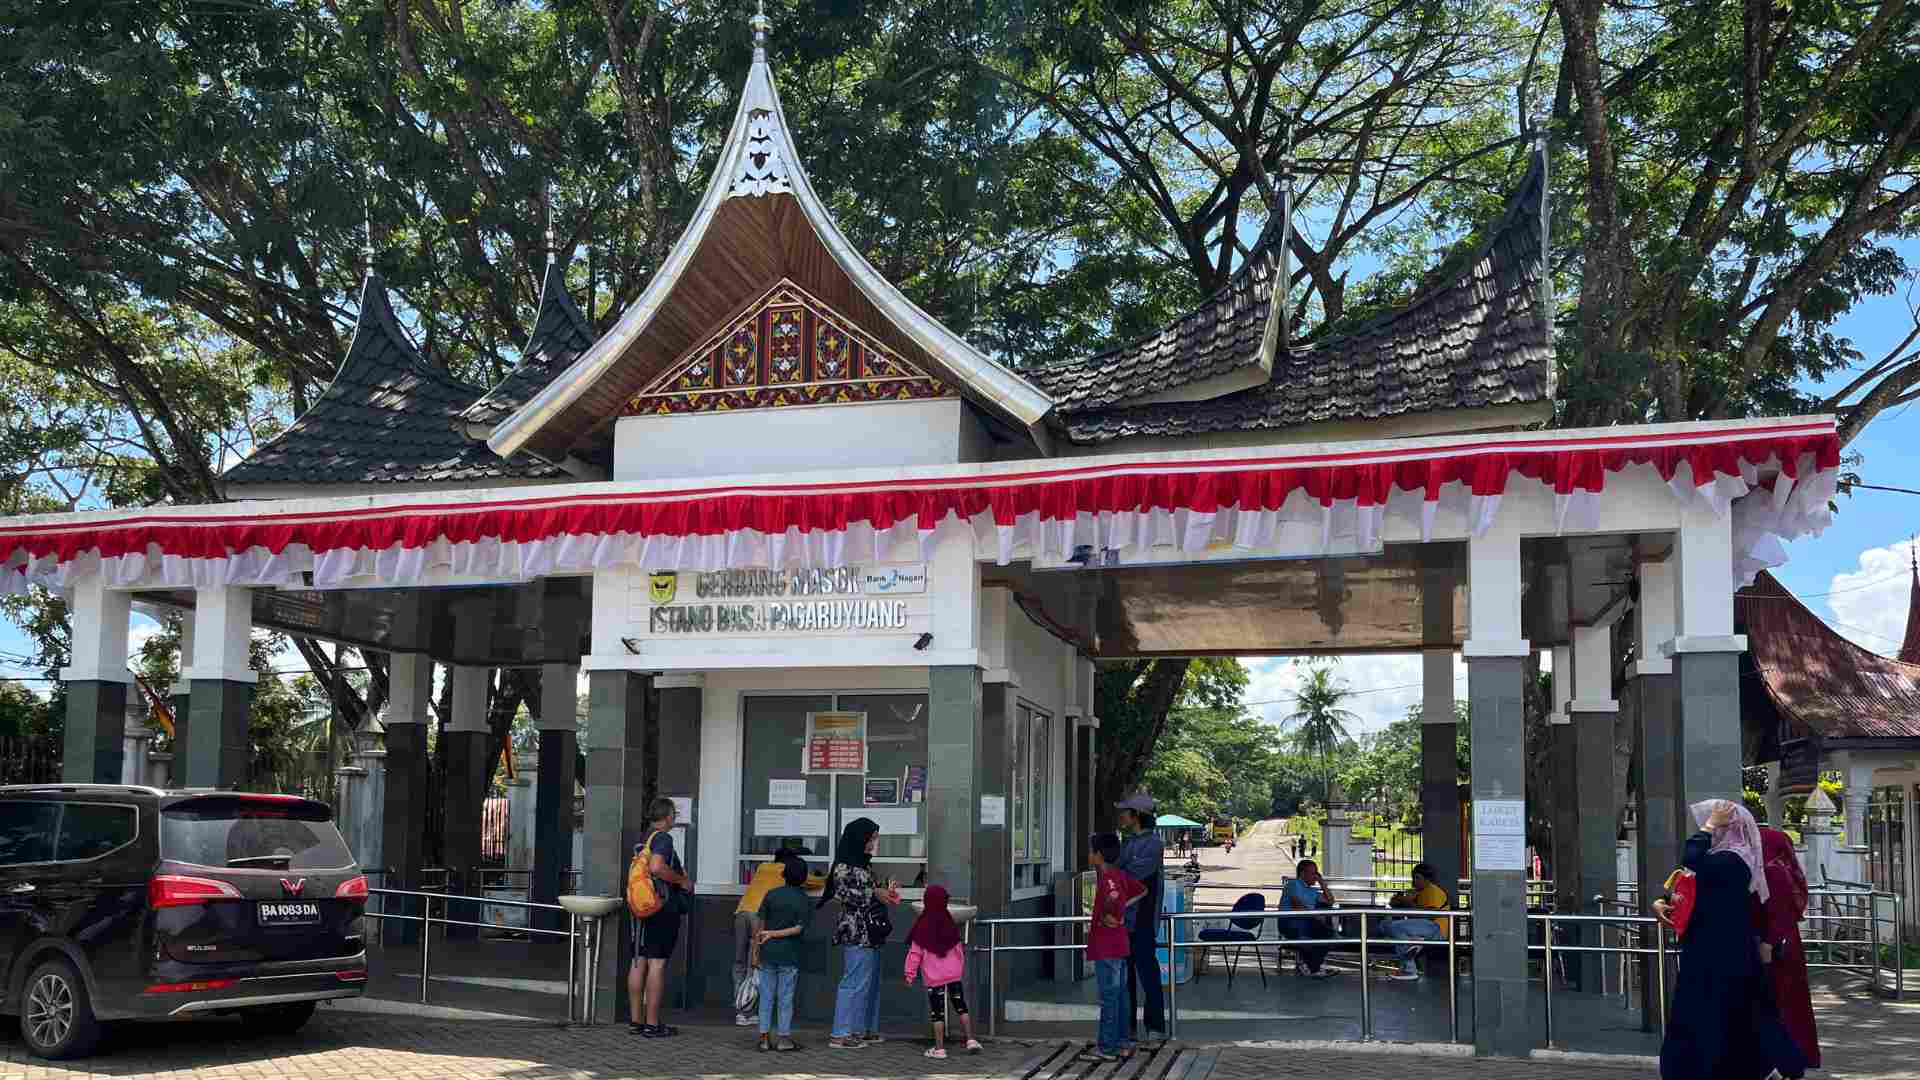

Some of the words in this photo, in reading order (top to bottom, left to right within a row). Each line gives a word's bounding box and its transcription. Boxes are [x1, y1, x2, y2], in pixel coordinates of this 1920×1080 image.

[696, 569, 785, 598] GERBANG
[650, 605, 713, 633] ISTANO
[717, 604, 766, 633] BASA
[768, 599, 906, 632] PAGARUYUANG
[261, 904, 277, 916] BA
[303, 903, 318, 916] DA
